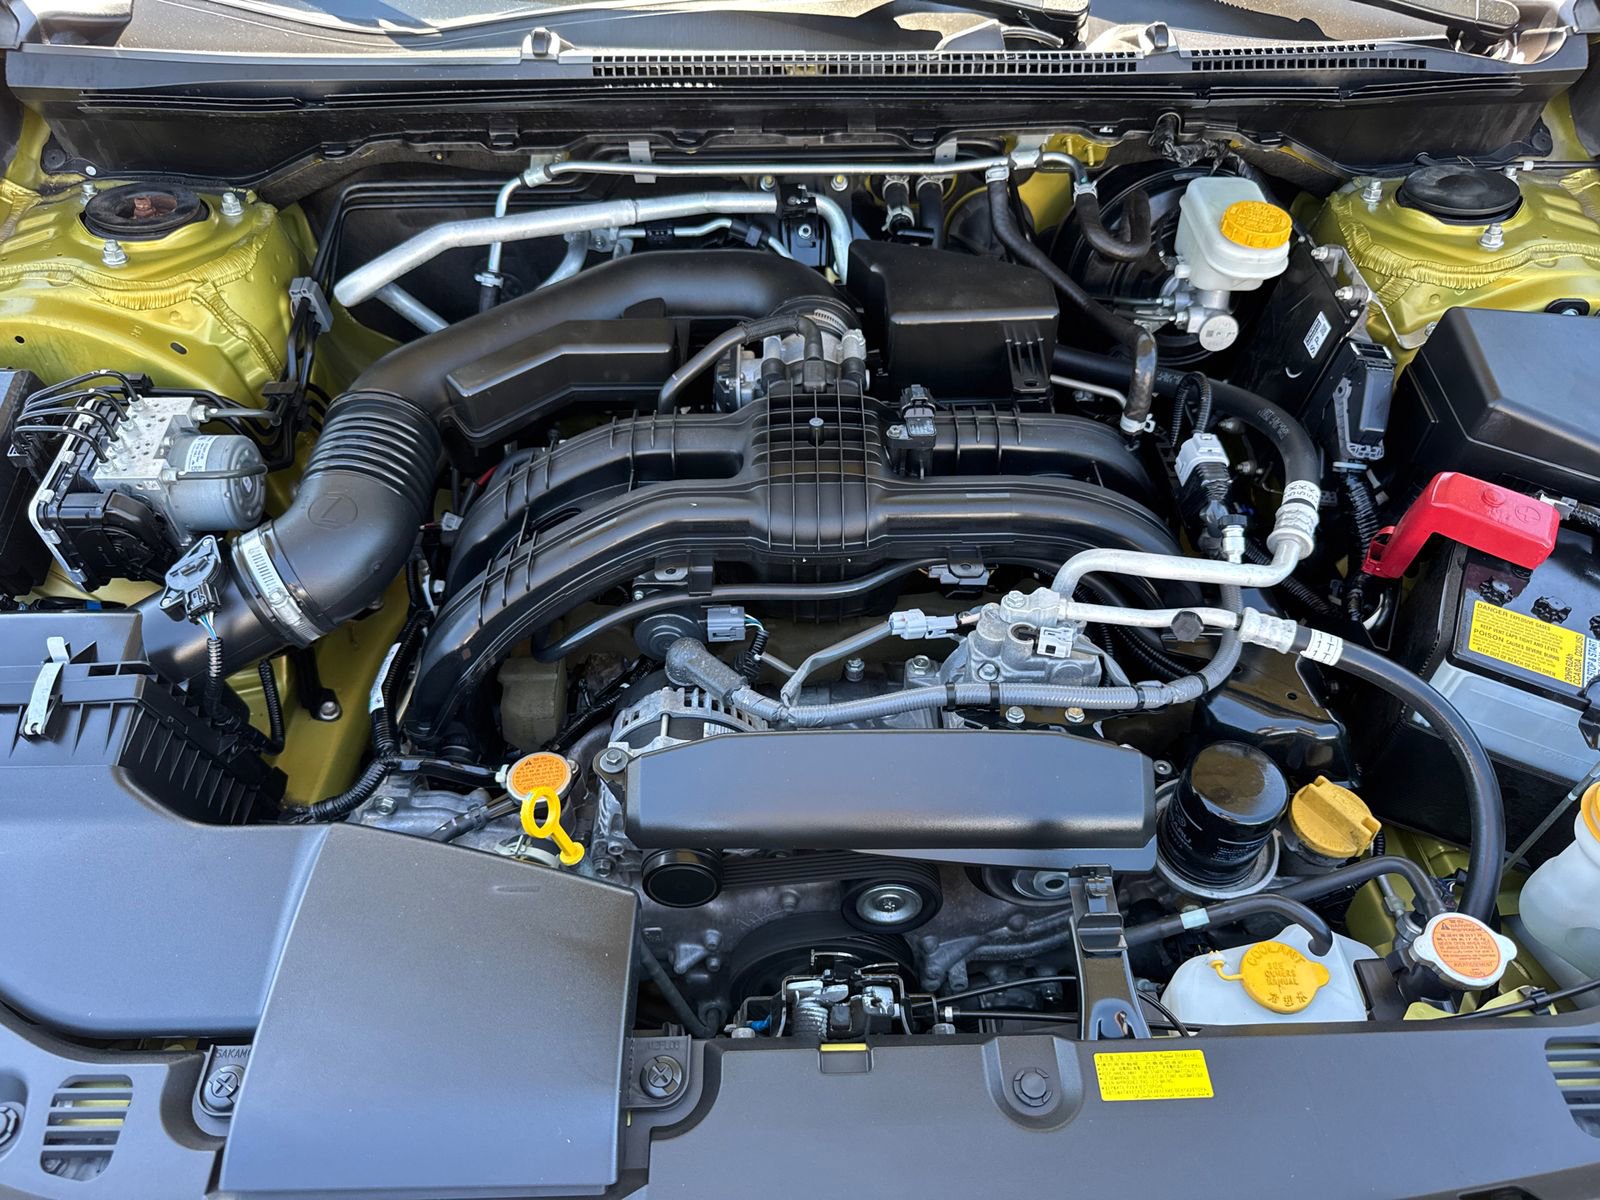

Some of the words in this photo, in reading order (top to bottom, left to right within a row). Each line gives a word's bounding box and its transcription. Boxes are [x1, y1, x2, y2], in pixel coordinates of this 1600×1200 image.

[1477, 603, 1508, 618] DANGER
[1473, 628, 1504, 643] POISON
[1505, 630, 1518, 640] CAPS
[1533, 640, 1544, 649] AND
[1544, 643, 1558, 654] LEVEL
[1531, 663, 1556, 677] CHILDREN
[1246, 943, 1306, 967] COOLANT
